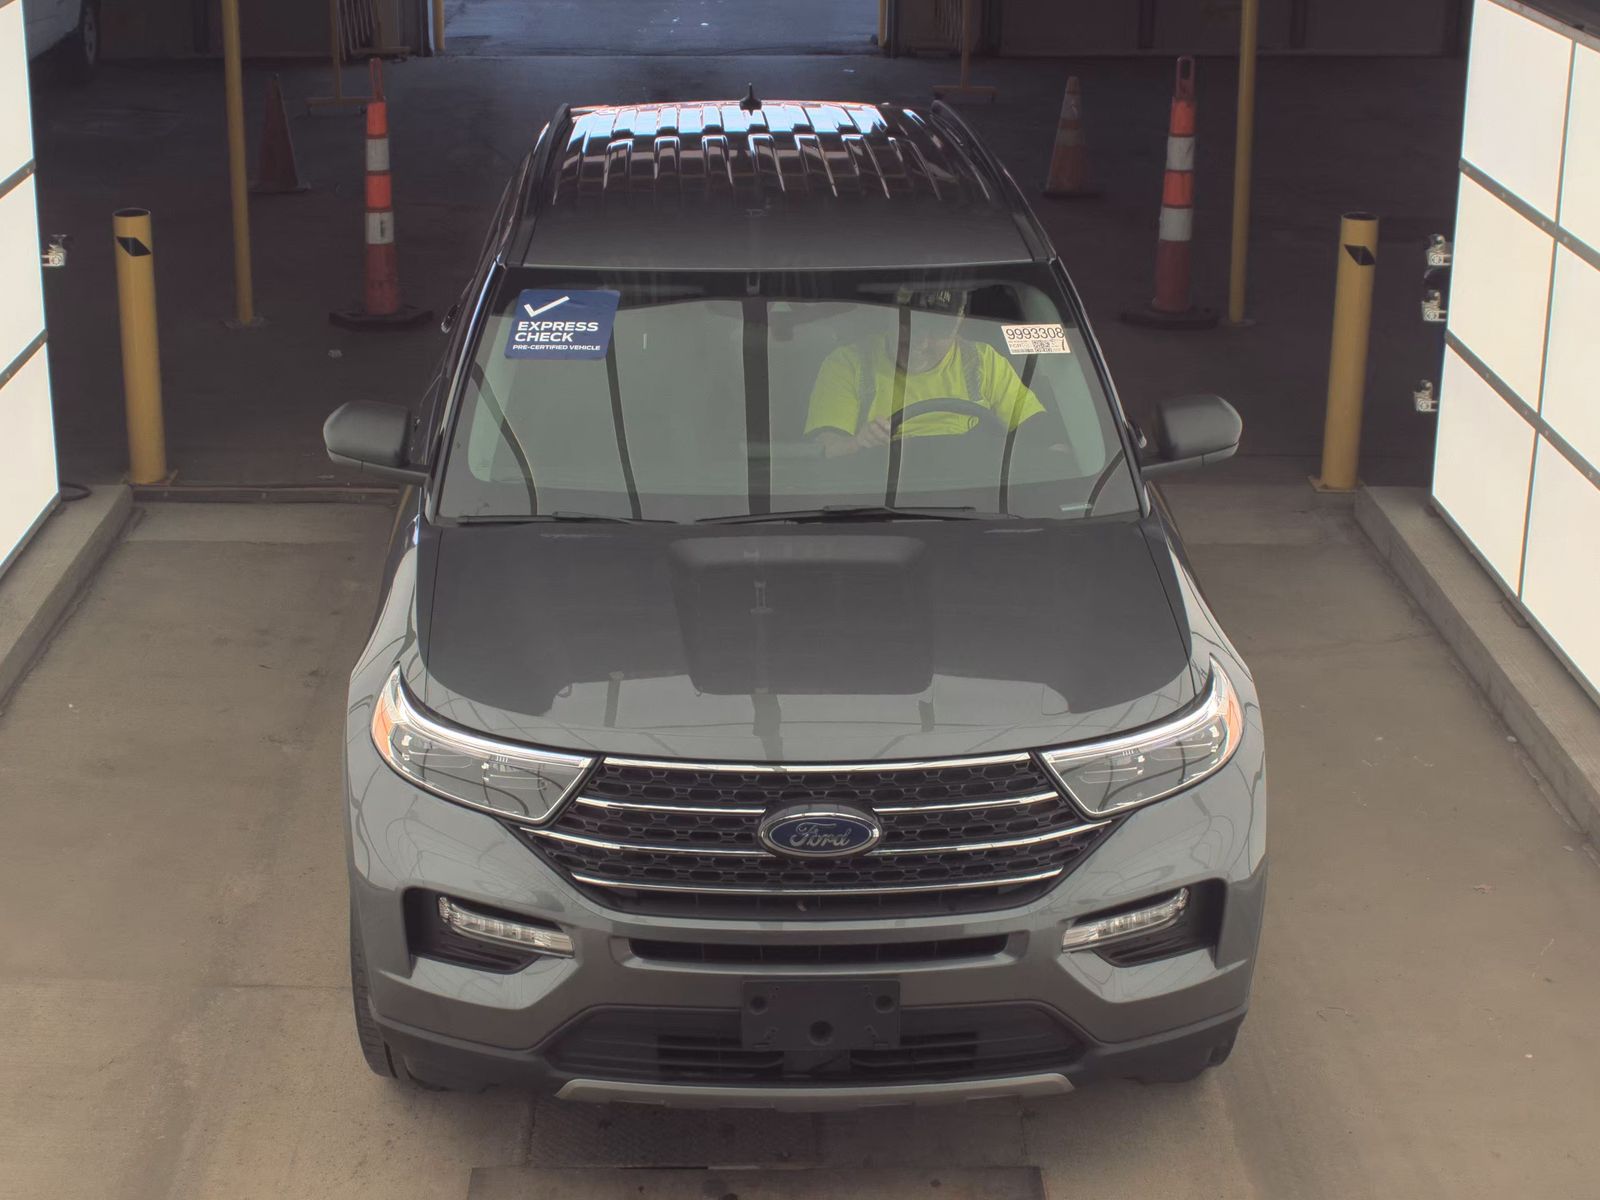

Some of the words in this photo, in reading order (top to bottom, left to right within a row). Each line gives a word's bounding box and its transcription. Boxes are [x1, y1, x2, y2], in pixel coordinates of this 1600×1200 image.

[517, 321, 599, 332] EXPRESS
[514, 332, 573, 342] CHECK
[1005, 327, 1065, 340] 9993308
[790, 822, 851, 847] Ford
